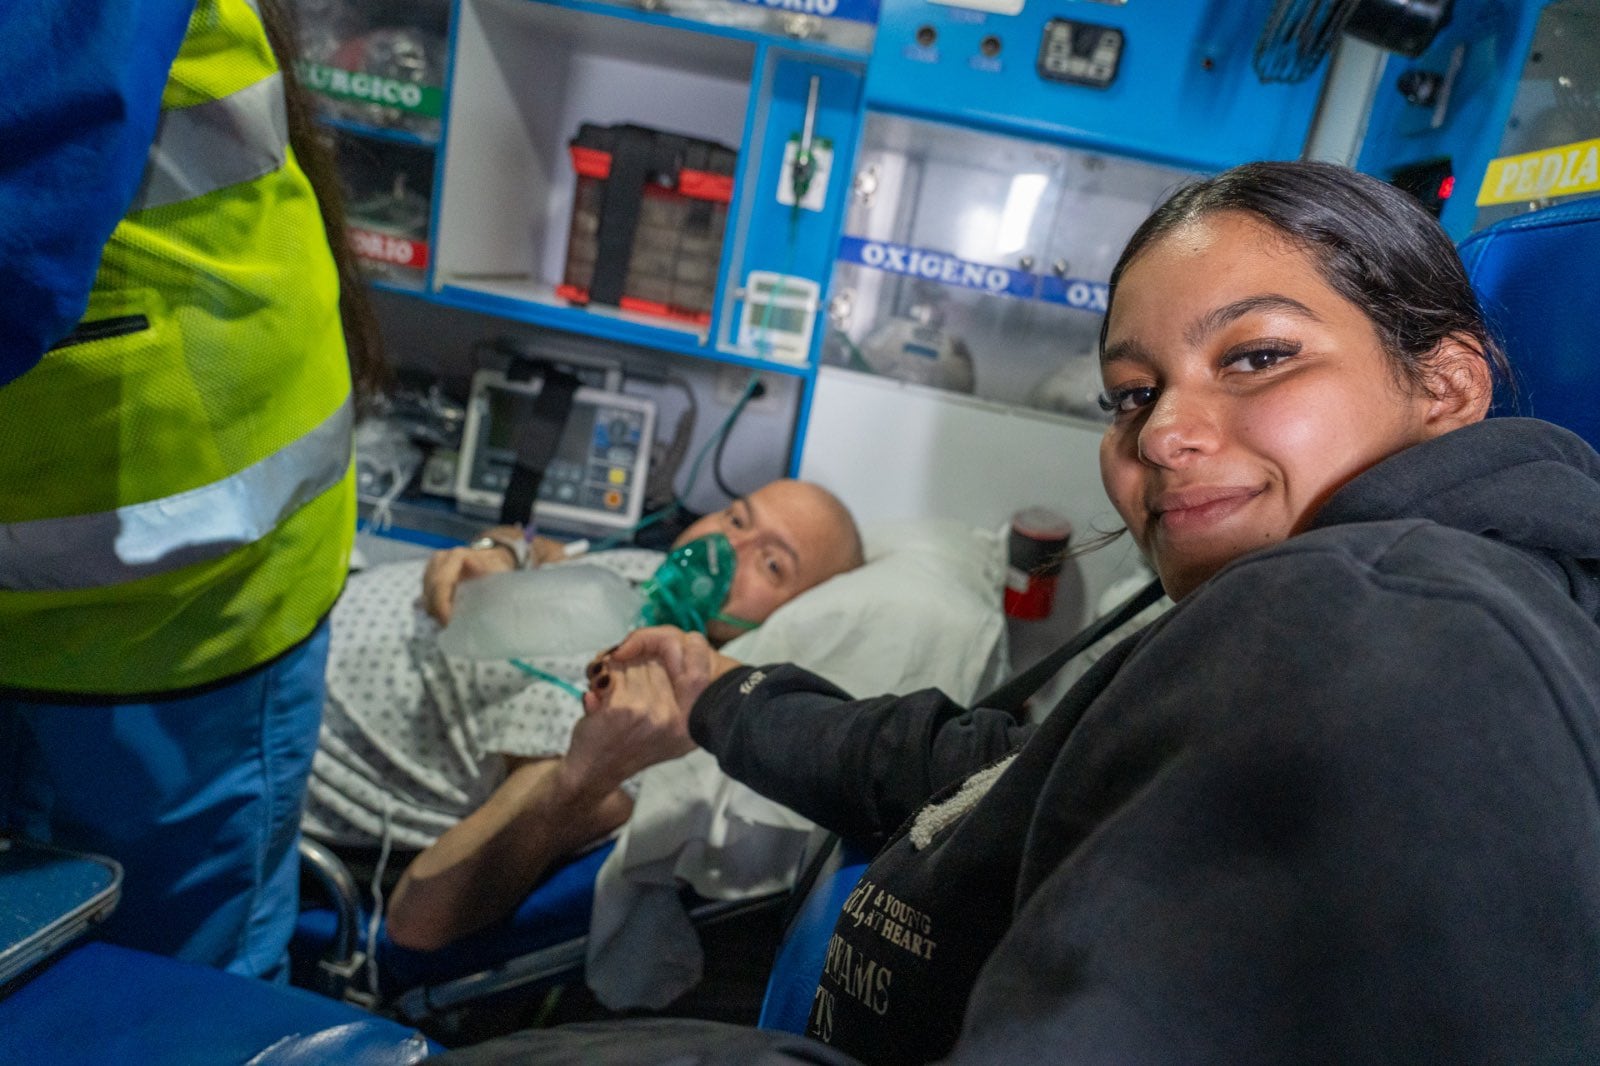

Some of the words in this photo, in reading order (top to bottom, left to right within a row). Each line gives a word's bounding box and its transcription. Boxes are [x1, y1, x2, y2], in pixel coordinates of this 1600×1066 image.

[1494, 147, 1598, 198] PEDIA
[861, 243, 1010, 291] OXIGENO
[863, 909, 884, 931] AT
[881, 918, 937, 960] HEART
[873, 889, 885, 907] &
[883, 894, 932, 935] YOUNG
